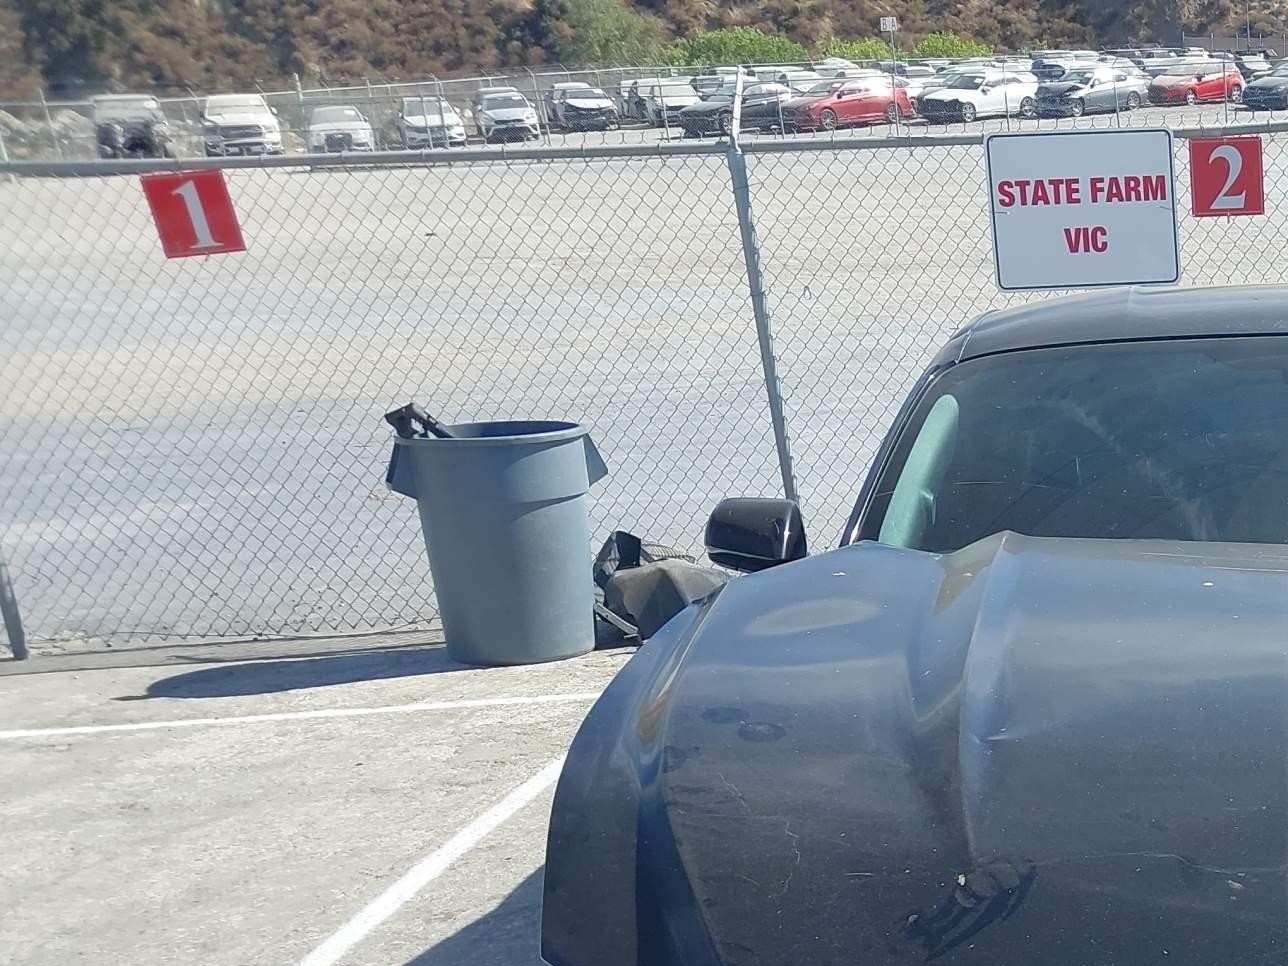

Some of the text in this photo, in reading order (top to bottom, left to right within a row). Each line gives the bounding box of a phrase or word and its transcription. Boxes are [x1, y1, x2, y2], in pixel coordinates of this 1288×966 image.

[998, 174, 1167, 208] STATE FARM
[1208, 144, 1247, 210] 2
[171, 179, 225, 249] 1
[1063, 225, 1109, 254] VIC
